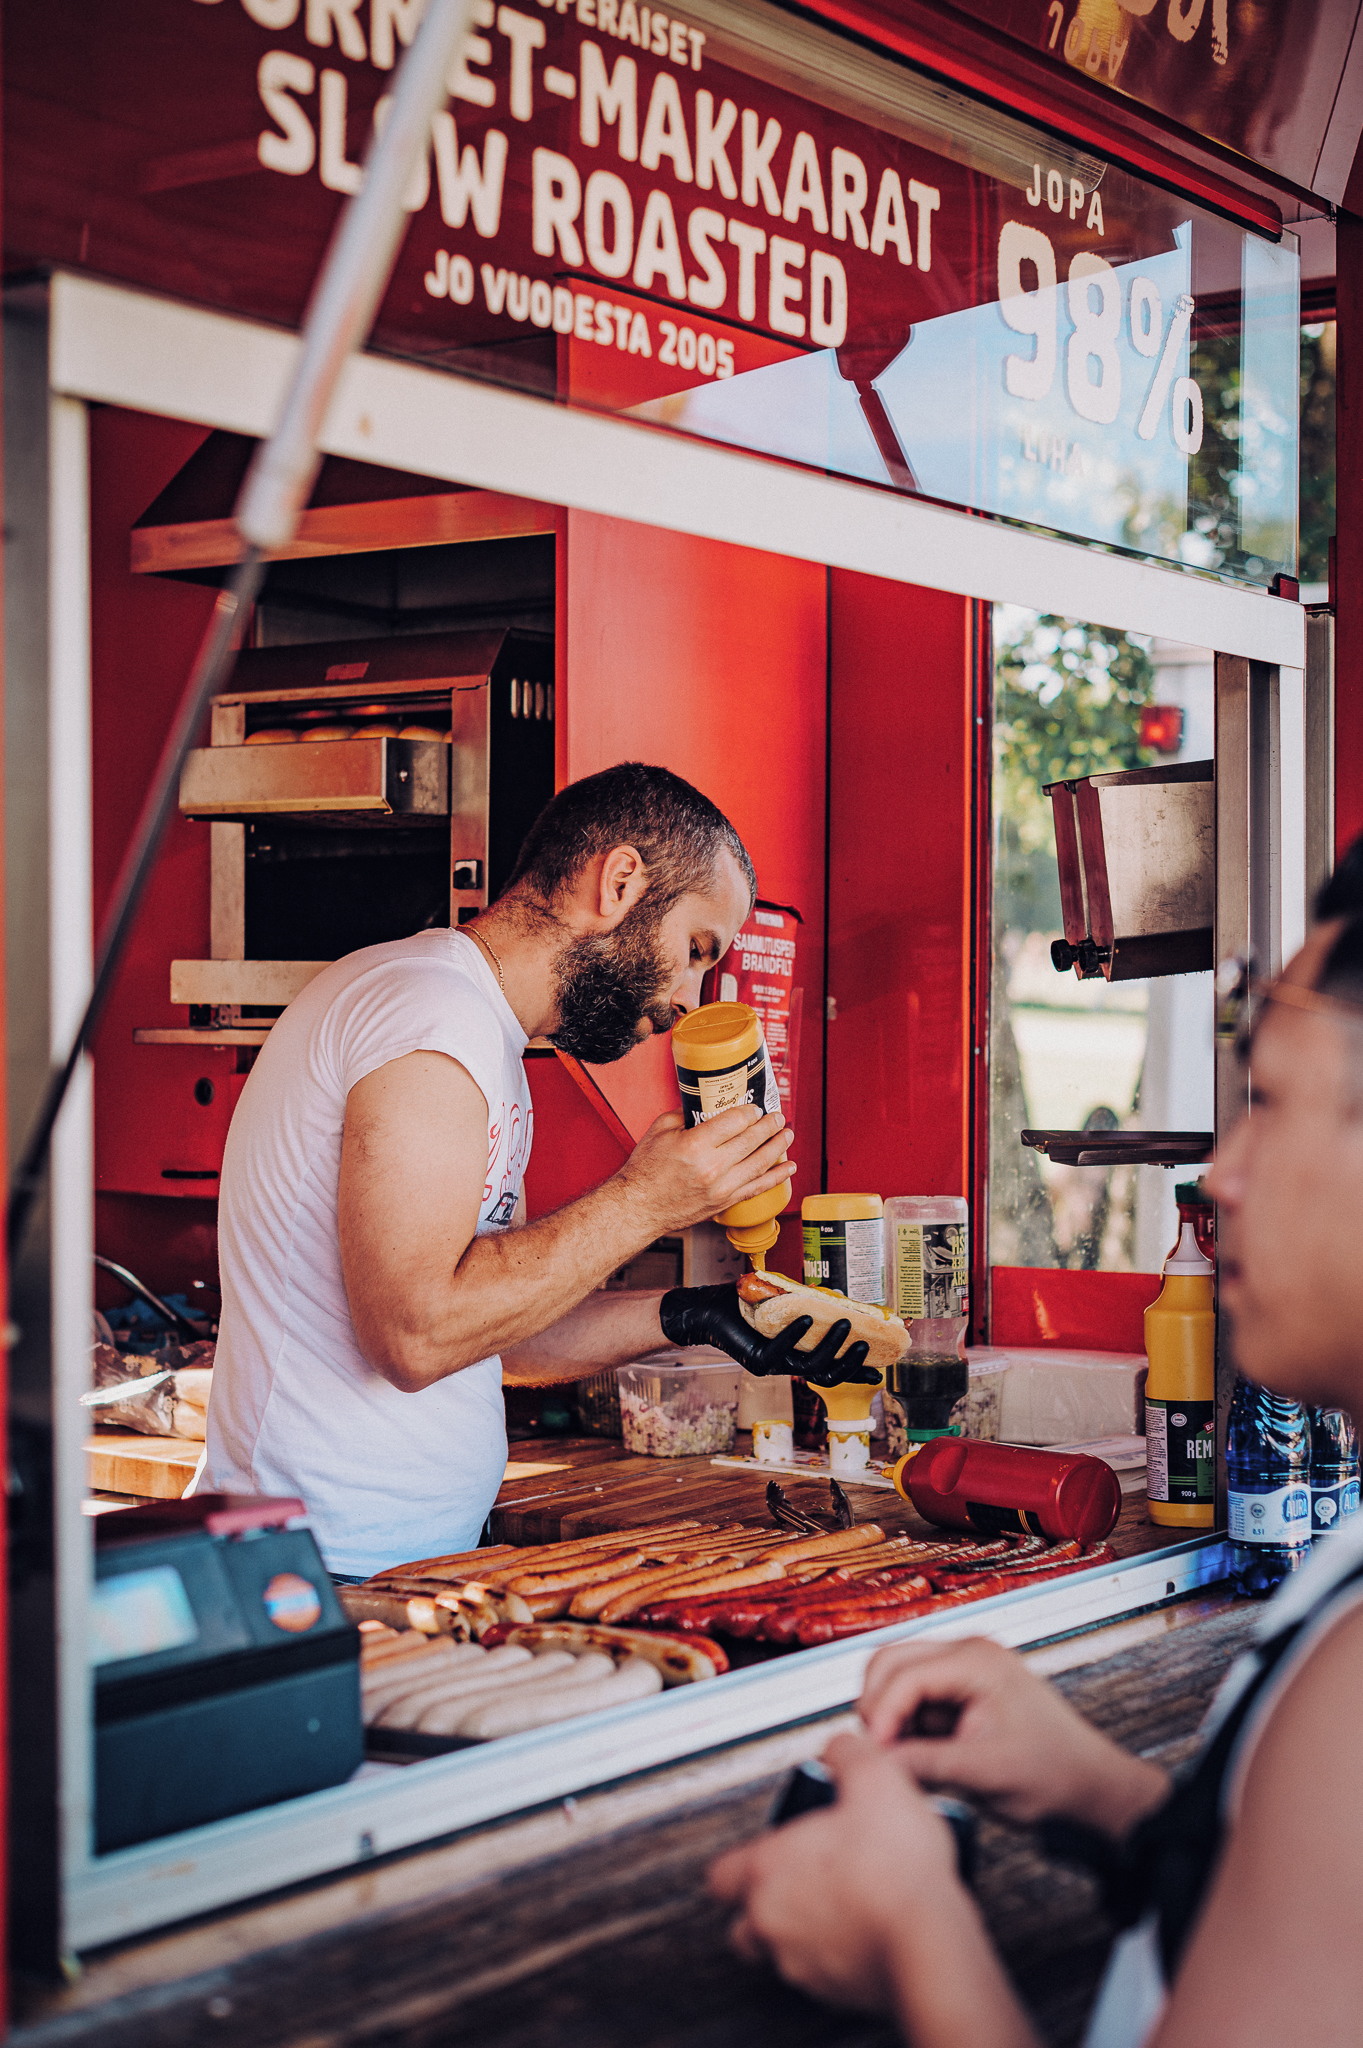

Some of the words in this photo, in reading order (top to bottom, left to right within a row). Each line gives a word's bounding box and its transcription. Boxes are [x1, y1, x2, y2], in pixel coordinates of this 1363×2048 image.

[532, 147, 848, 348] ROASTED
[1026, 164, 1105, 236] JOPA
[424, 249, 475, 305] JO
[481, 262, 652, 358] VUODESTA
[658, 320, 735, 379] 2005
[998, 220, 1204, 455] 98%
